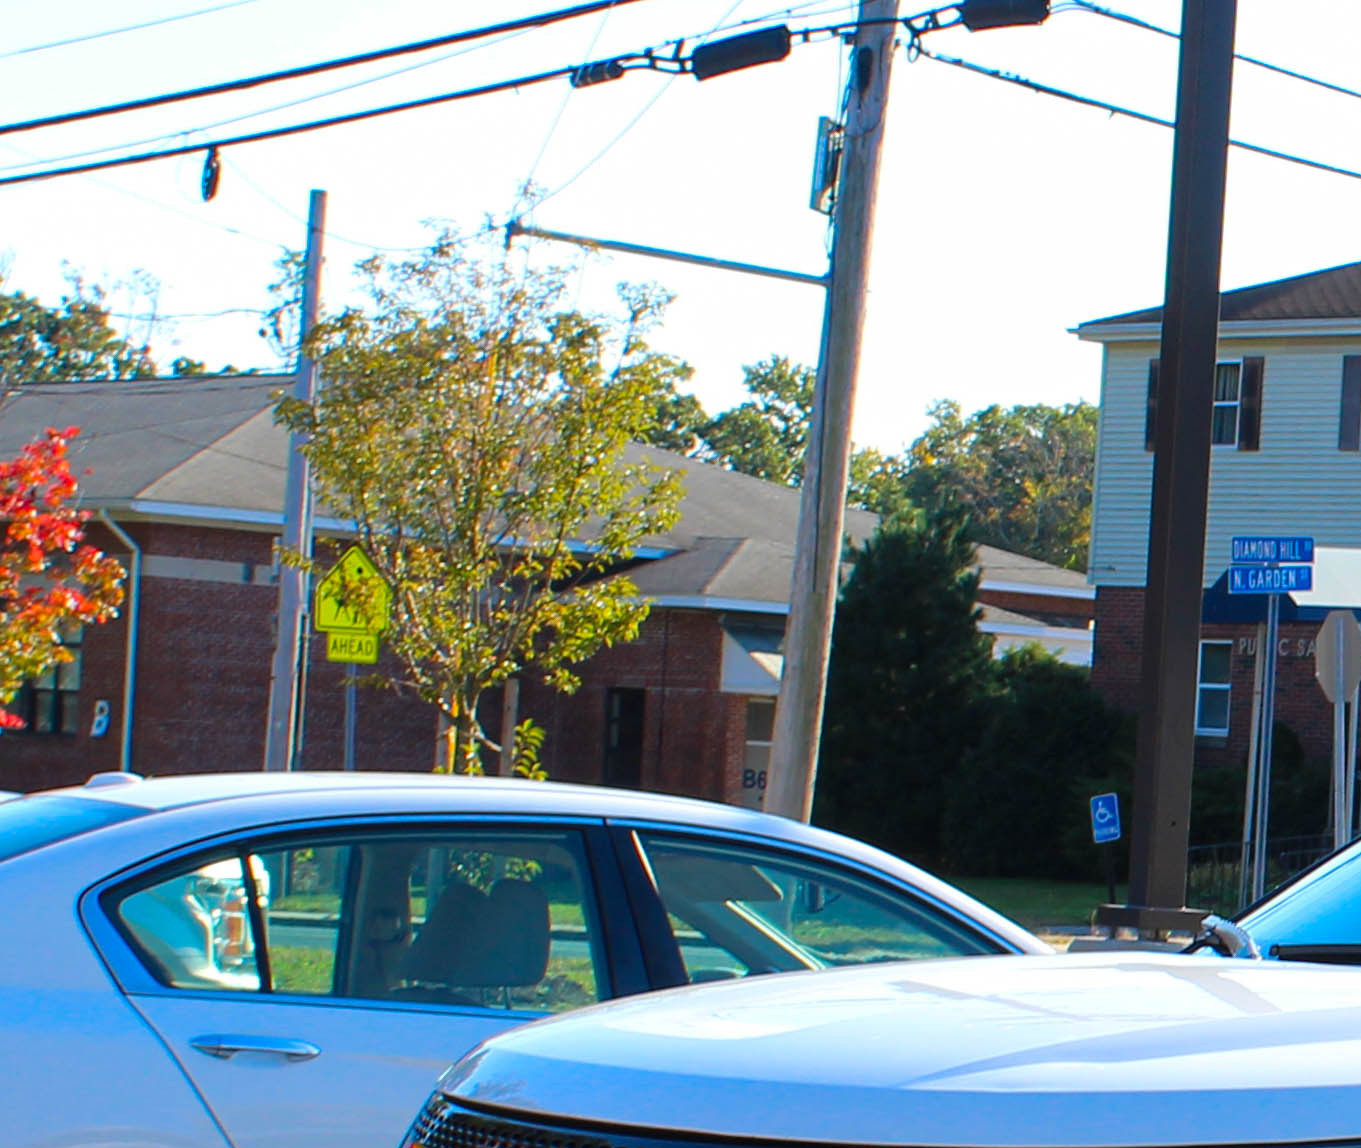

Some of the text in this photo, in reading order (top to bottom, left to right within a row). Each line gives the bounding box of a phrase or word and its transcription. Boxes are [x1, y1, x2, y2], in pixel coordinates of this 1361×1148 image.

[1234, 540, 1277, 560] DIAMOND
[1280, 541, 1302, 560] HILL
[1234, 569, 1246, 589] N.
[1248, 569, 1297, 589] GARDEN
[331, 639, 374, 656] AHEAD
